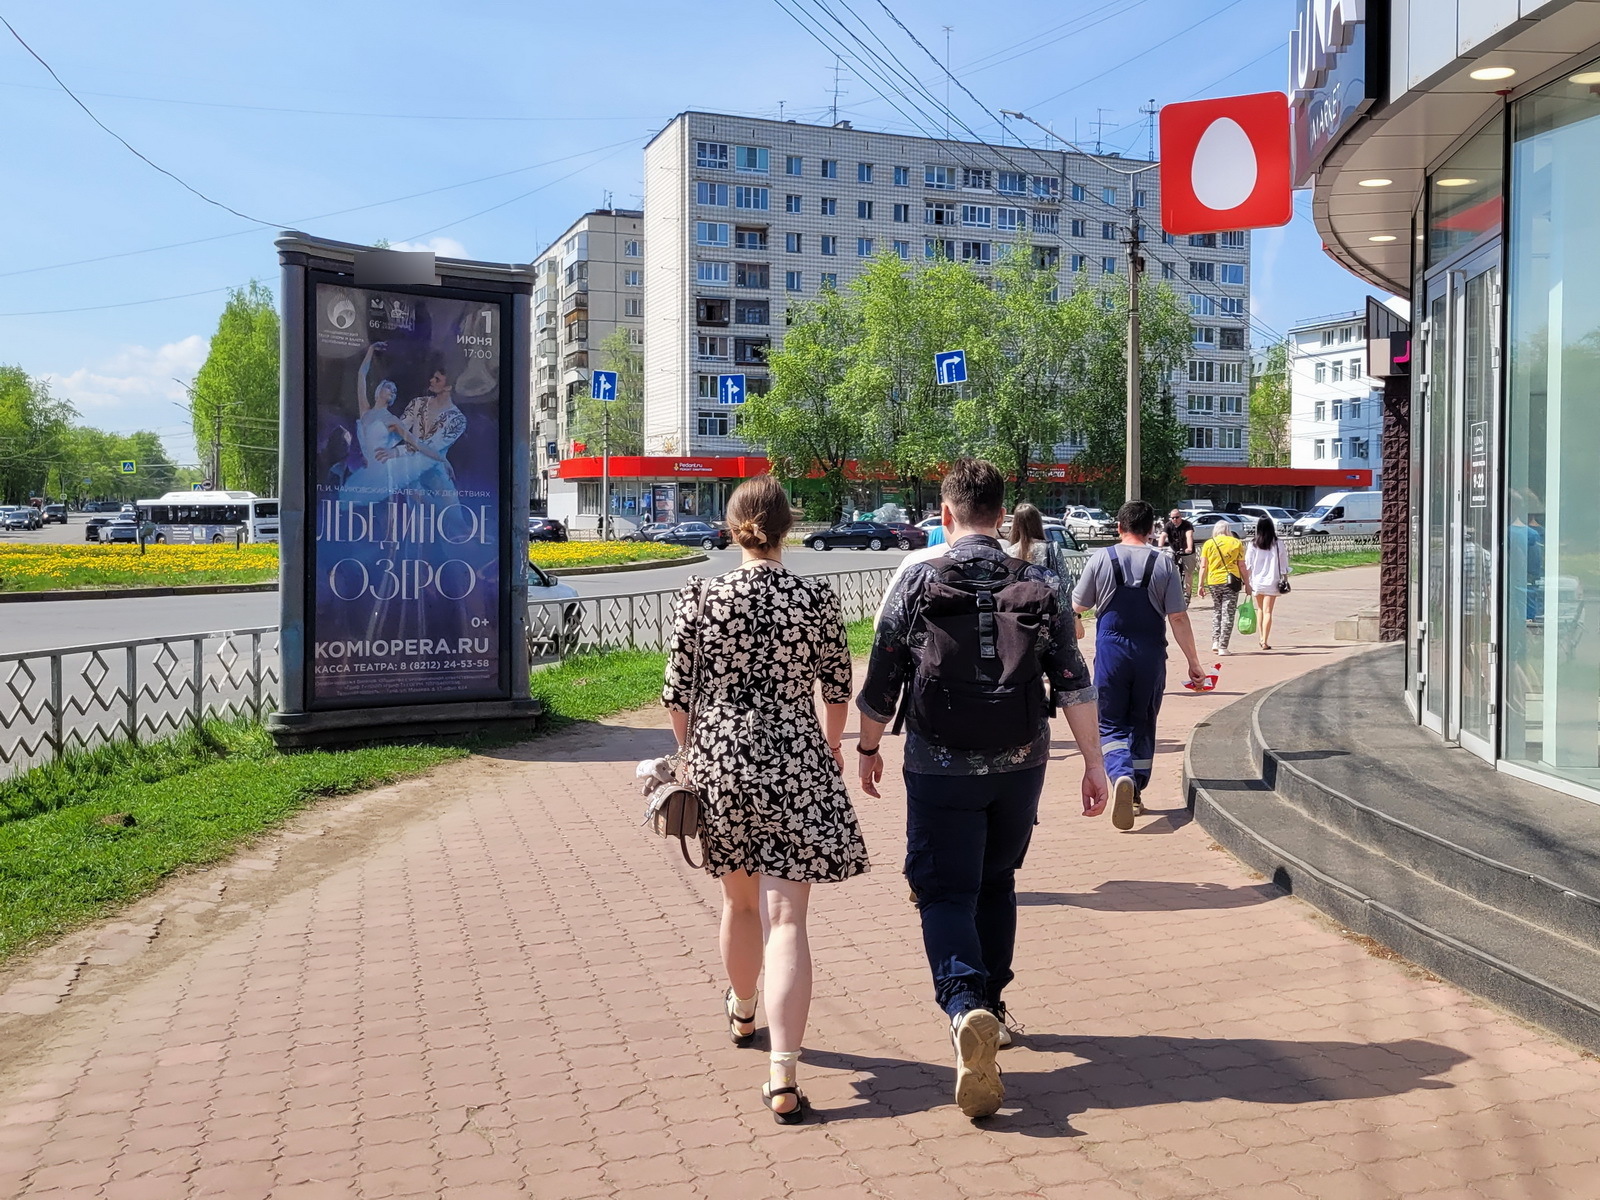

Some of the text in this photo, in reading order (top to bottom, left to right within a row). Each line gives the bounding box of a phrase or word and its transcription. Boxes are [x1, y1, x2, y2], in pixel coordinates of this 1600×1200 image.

[481, 311, 492, 334] 1
[456, 334, 493, 347] ИЮНЯ
[463, 348, 493, 360] 17:00
[441, 489, 491, 498] ДЕЙСТВИЯХ
[316, 499, 493, 550] ЛЕБЕДИНОЕ
[329, 558, 477, 601] ОЗЕРО
[470, 616, 490, 628] 0+
[314, 637, 489, 659] KOMIOPERA.RU
[314, 659, 490, 675] КАССА ТЕАТРА: 8 (8212) 24-53-58
